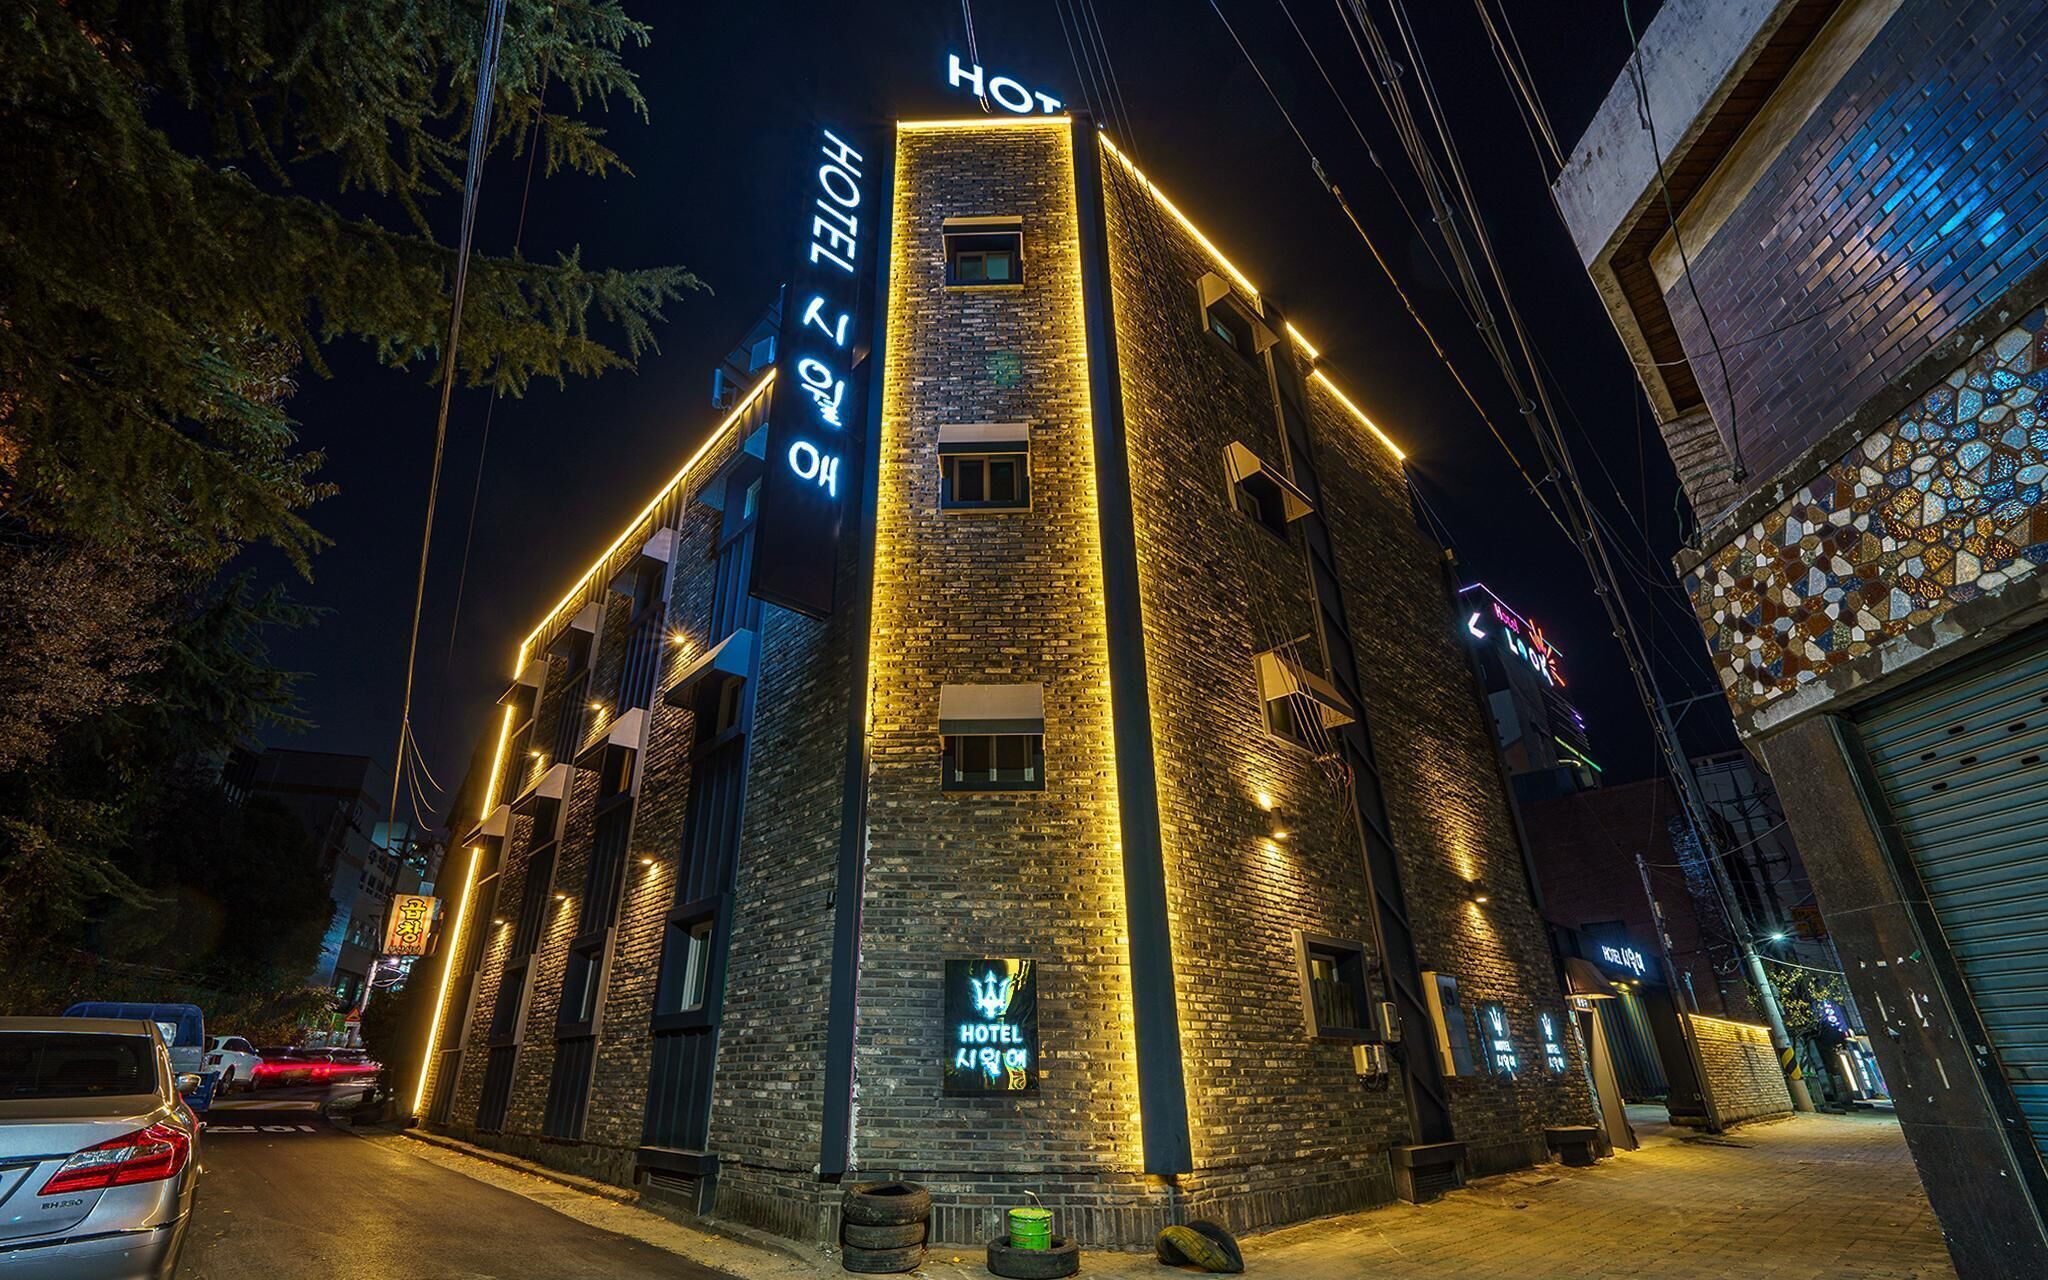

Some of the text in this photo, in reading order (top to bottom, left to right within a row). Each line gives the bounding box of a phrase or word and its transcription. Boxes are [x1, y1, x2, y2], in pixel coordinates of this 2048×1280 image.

[788, 129, 866, 498] HOTEL 시월애
[395, 898, 428, 943] 곱창
[960, 1023, 1023, 1044] HOTEL
[955, 1047, 1028, 1077] 시월애
